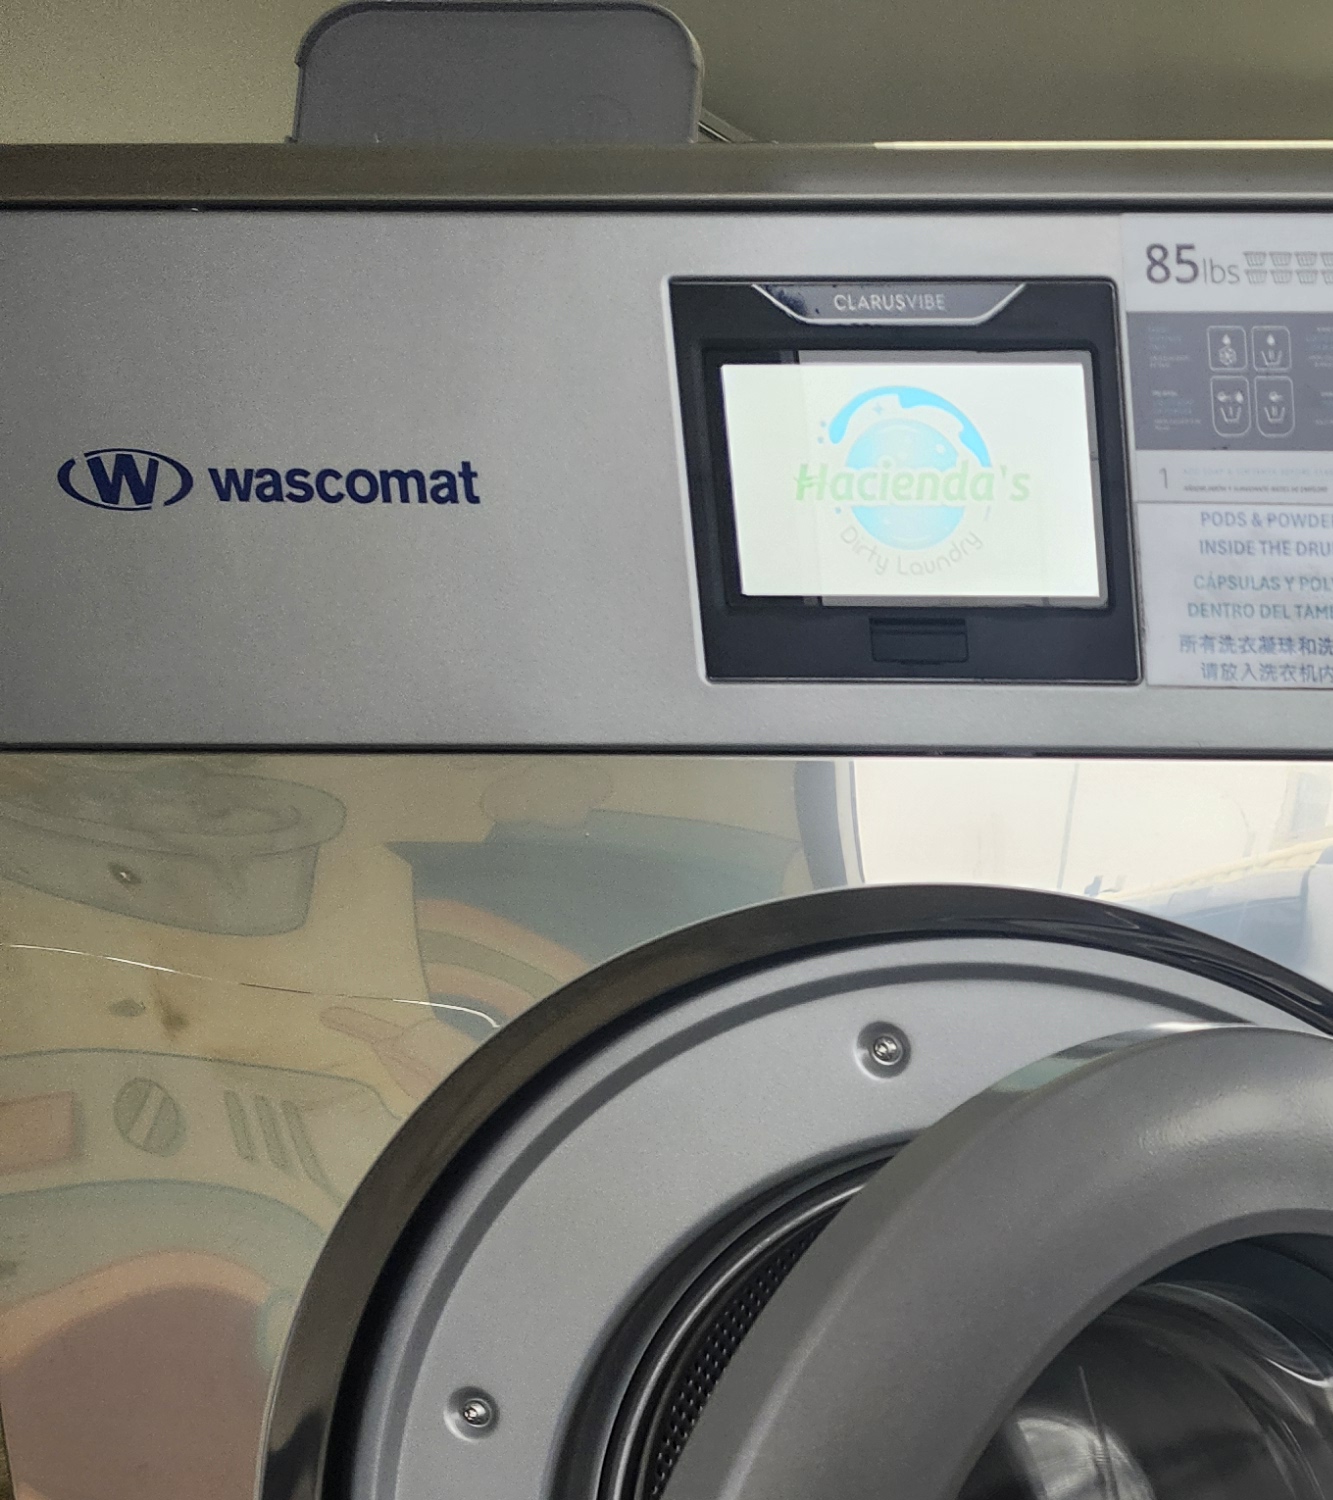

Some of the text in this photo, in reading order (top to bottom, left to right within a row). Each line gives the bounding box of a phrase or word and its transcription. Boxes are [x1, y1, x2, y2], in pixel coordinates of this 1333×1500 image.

[834, 294, 945, 310] CLARUSVIBE
[208, 460, 480, 505] wascomat
[795, 462, 1031, 502] Hacienda's
[1200, 511, 1247, 528] PODS
[1251, 512, 1263, 528] &
[840, 525, 985, 577] Dirty Laundry
[1199, 539, 1255, 556] INSIDE
[1260, 540, 1291, 556] THE
[1193, 573, 1281, 592] CÁPSULAS
[1285, 576, 1296, 592] Y
[1187, 602, 1255, 619] DENTRO
[1260, 603, 1291, 620] DEL
